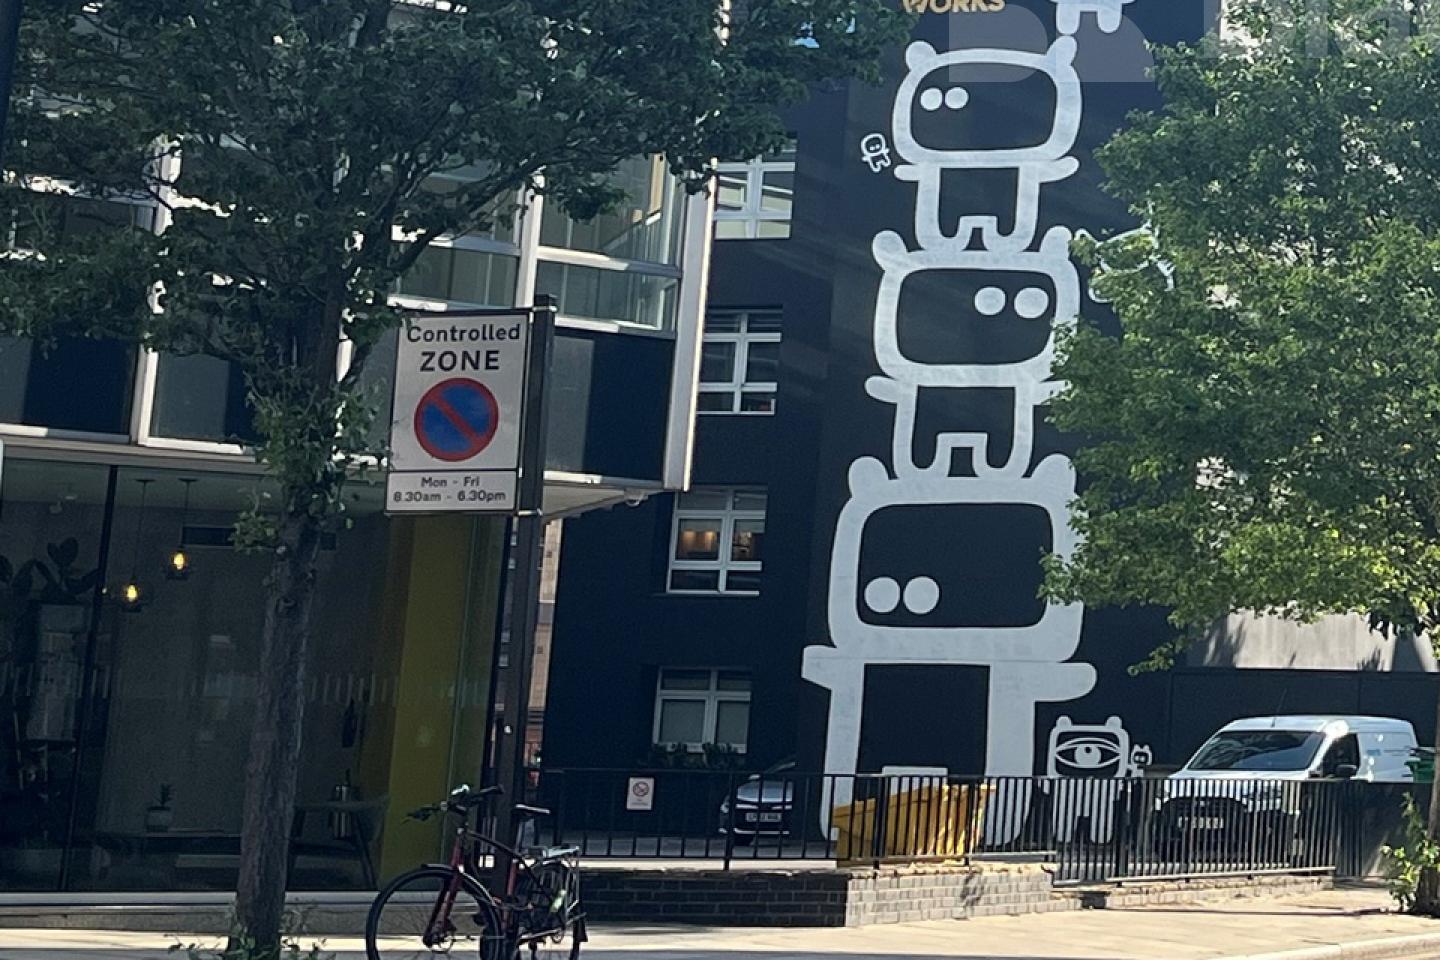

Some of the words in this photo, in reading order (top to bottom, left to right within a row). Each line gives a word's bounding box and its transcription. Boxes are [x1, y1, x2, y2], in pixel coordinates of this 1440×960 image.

[407, 323, 521, 343] Controlled
[419, 350, 500, 372] ZONE
[421, 476, 448, 487] Mon
[463, 475, 480, 487] Fri
